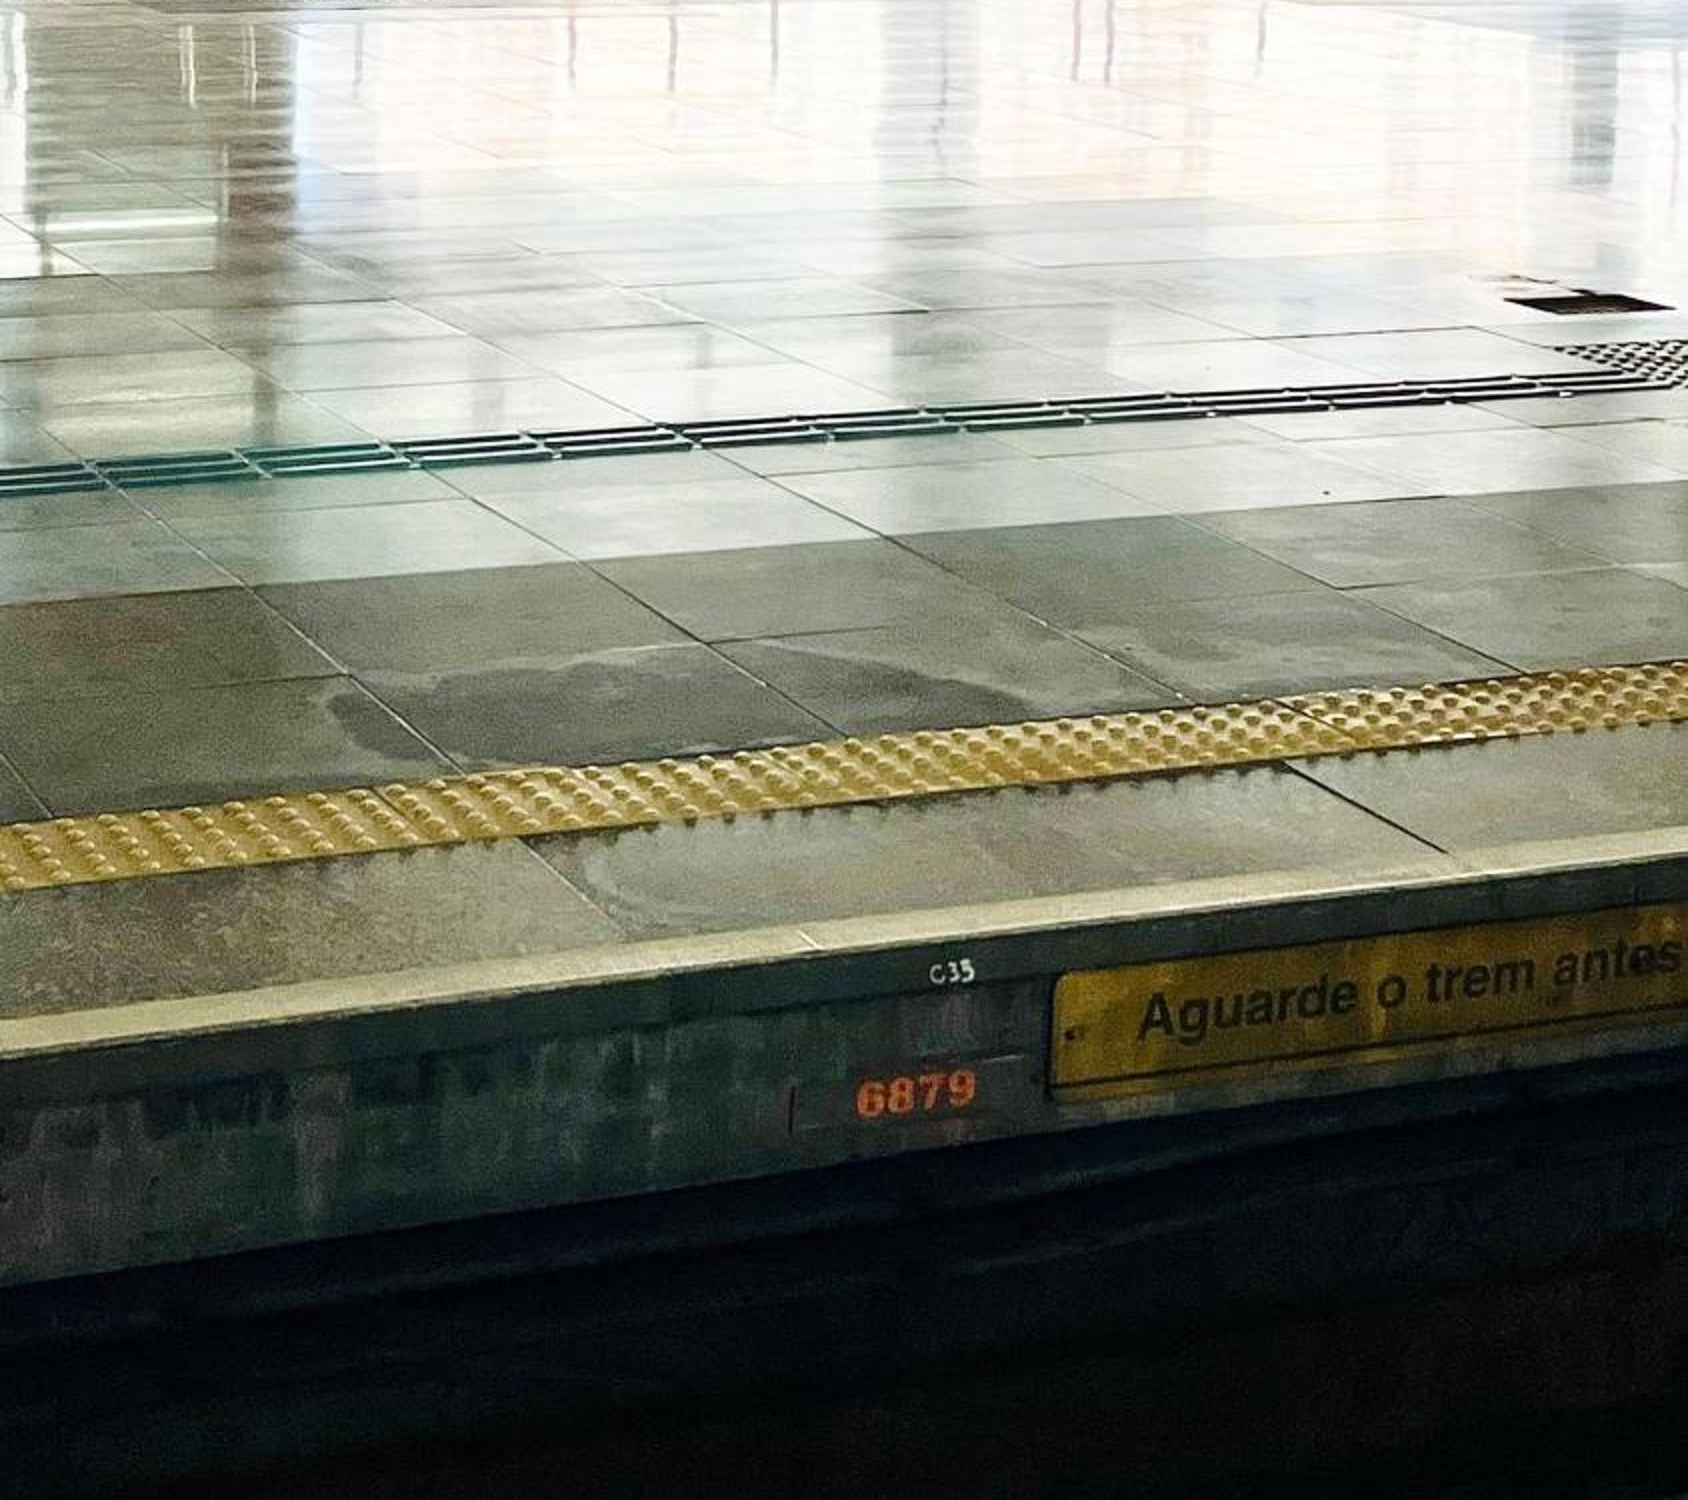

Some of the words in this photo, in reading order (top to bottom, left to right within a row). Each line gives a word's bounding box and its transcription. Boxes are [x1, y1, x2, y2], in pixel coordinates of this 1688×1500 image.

[929, 958, 975, 984] C35
[1136, 972, 1359, 1045] Aguarde
[1377, 973, 1407, 1008] o
[1426, 959, 1536, 1002] trem
[1553, 938, 1681, 985] antes
[856, 1068, 976, 1118] 6879
